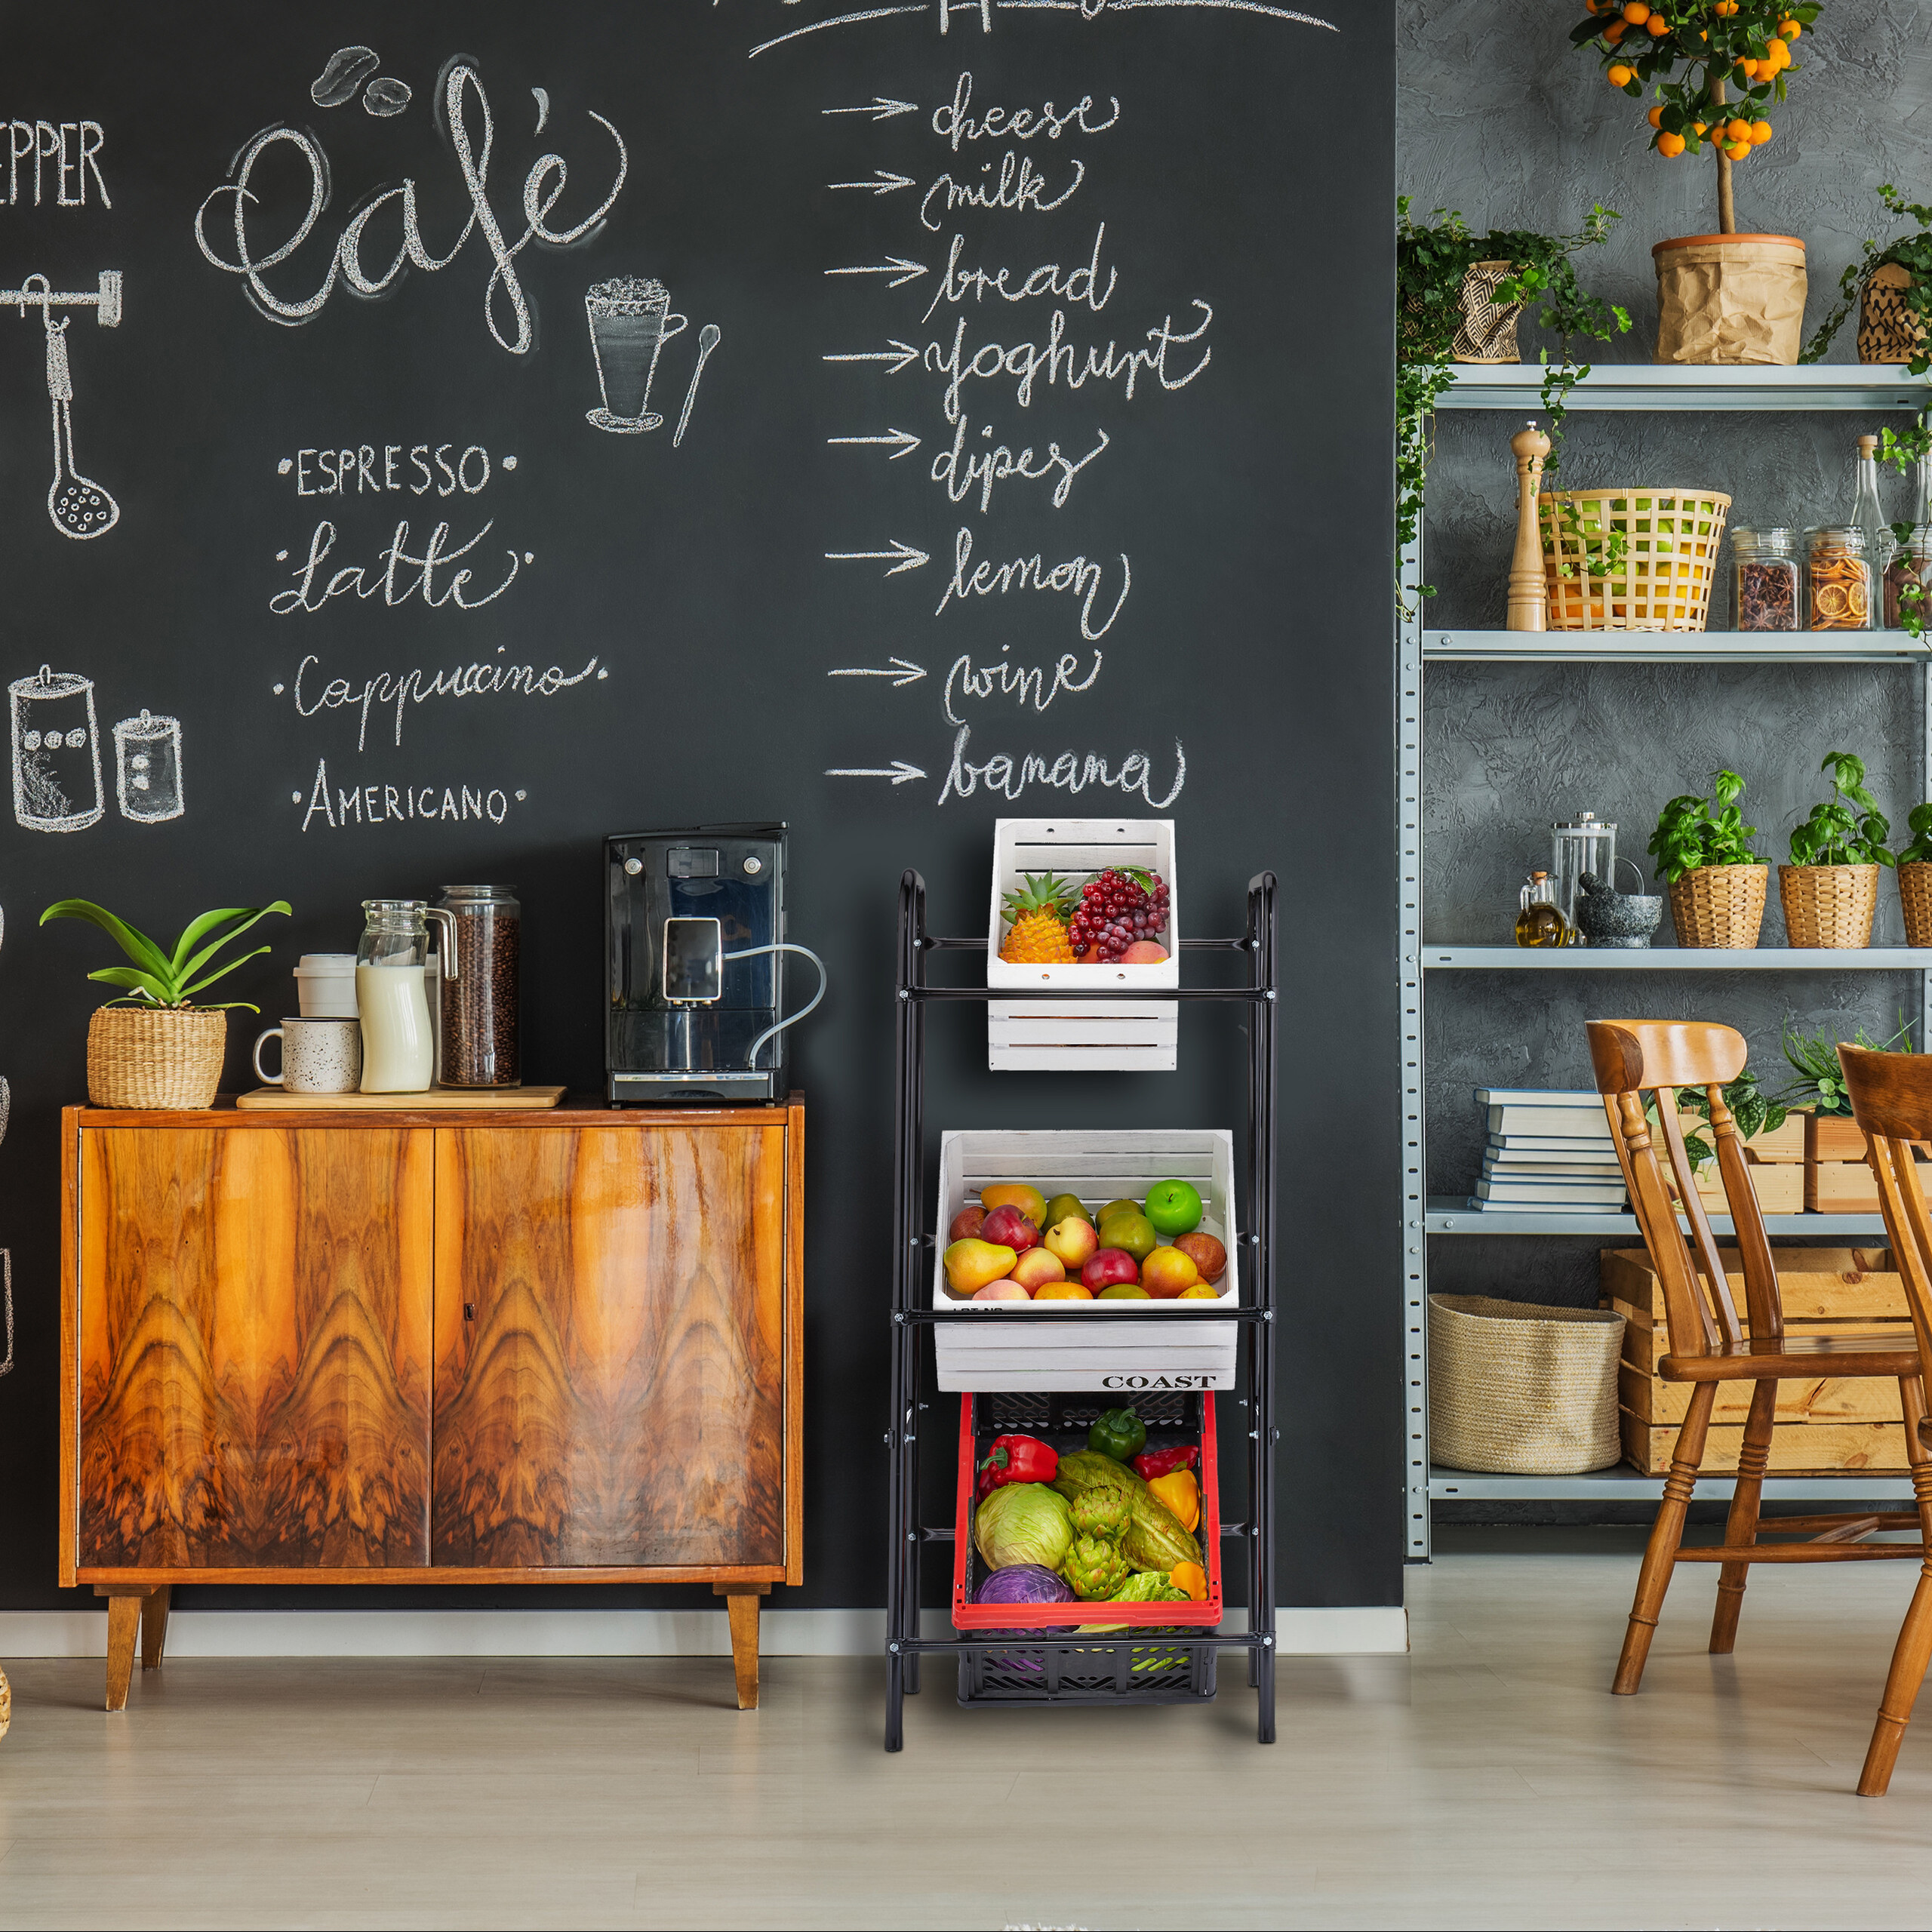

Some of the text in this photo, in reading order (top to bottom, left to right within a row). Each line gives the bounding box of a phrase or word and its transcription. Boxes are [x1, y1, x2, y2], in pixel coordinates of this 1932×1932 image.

[932, 72, 1120, 151] cheese
[921, 150, 1084, 231] milk
[921, 222, 1117, 323] bread
[297, 444, 491, 496] ESPRESSO
[269, 518, 518, 614] Latte
[935, 528, 1131, 640] lemon
[943, 645, 1103, 725] wine
[938, 724, 1186, 808] banana
[1102, 1376, 1217, 1389] COAST
